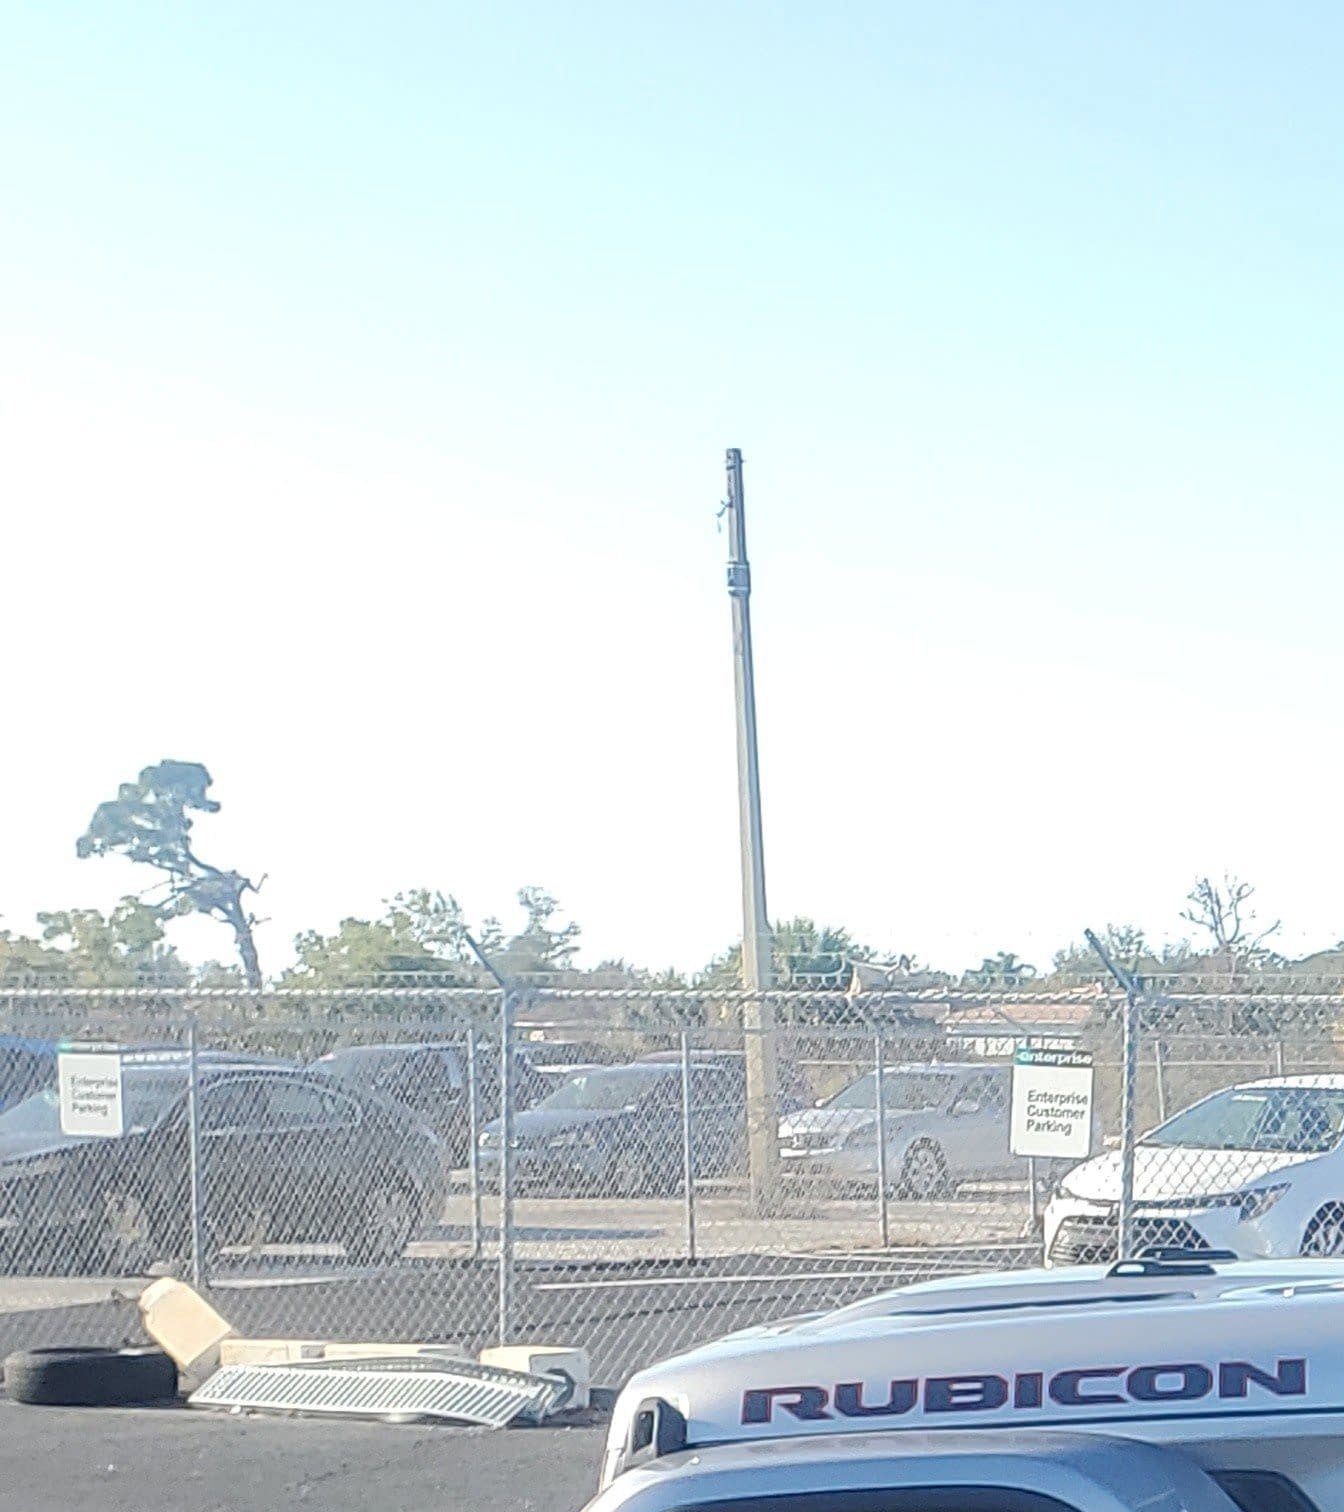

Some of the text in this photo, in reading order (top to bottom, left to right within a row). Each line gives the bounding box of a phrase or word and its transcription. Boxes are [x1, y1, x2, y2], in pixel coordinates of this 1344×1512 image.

[1027, 1089, 1088, 1106] Enterprise
[1026, 1104, 1086, 1120] Customer
[1026, 1119, 1072, 1137] Parking
[740, 1358, 1308, 1425] RUBICON
